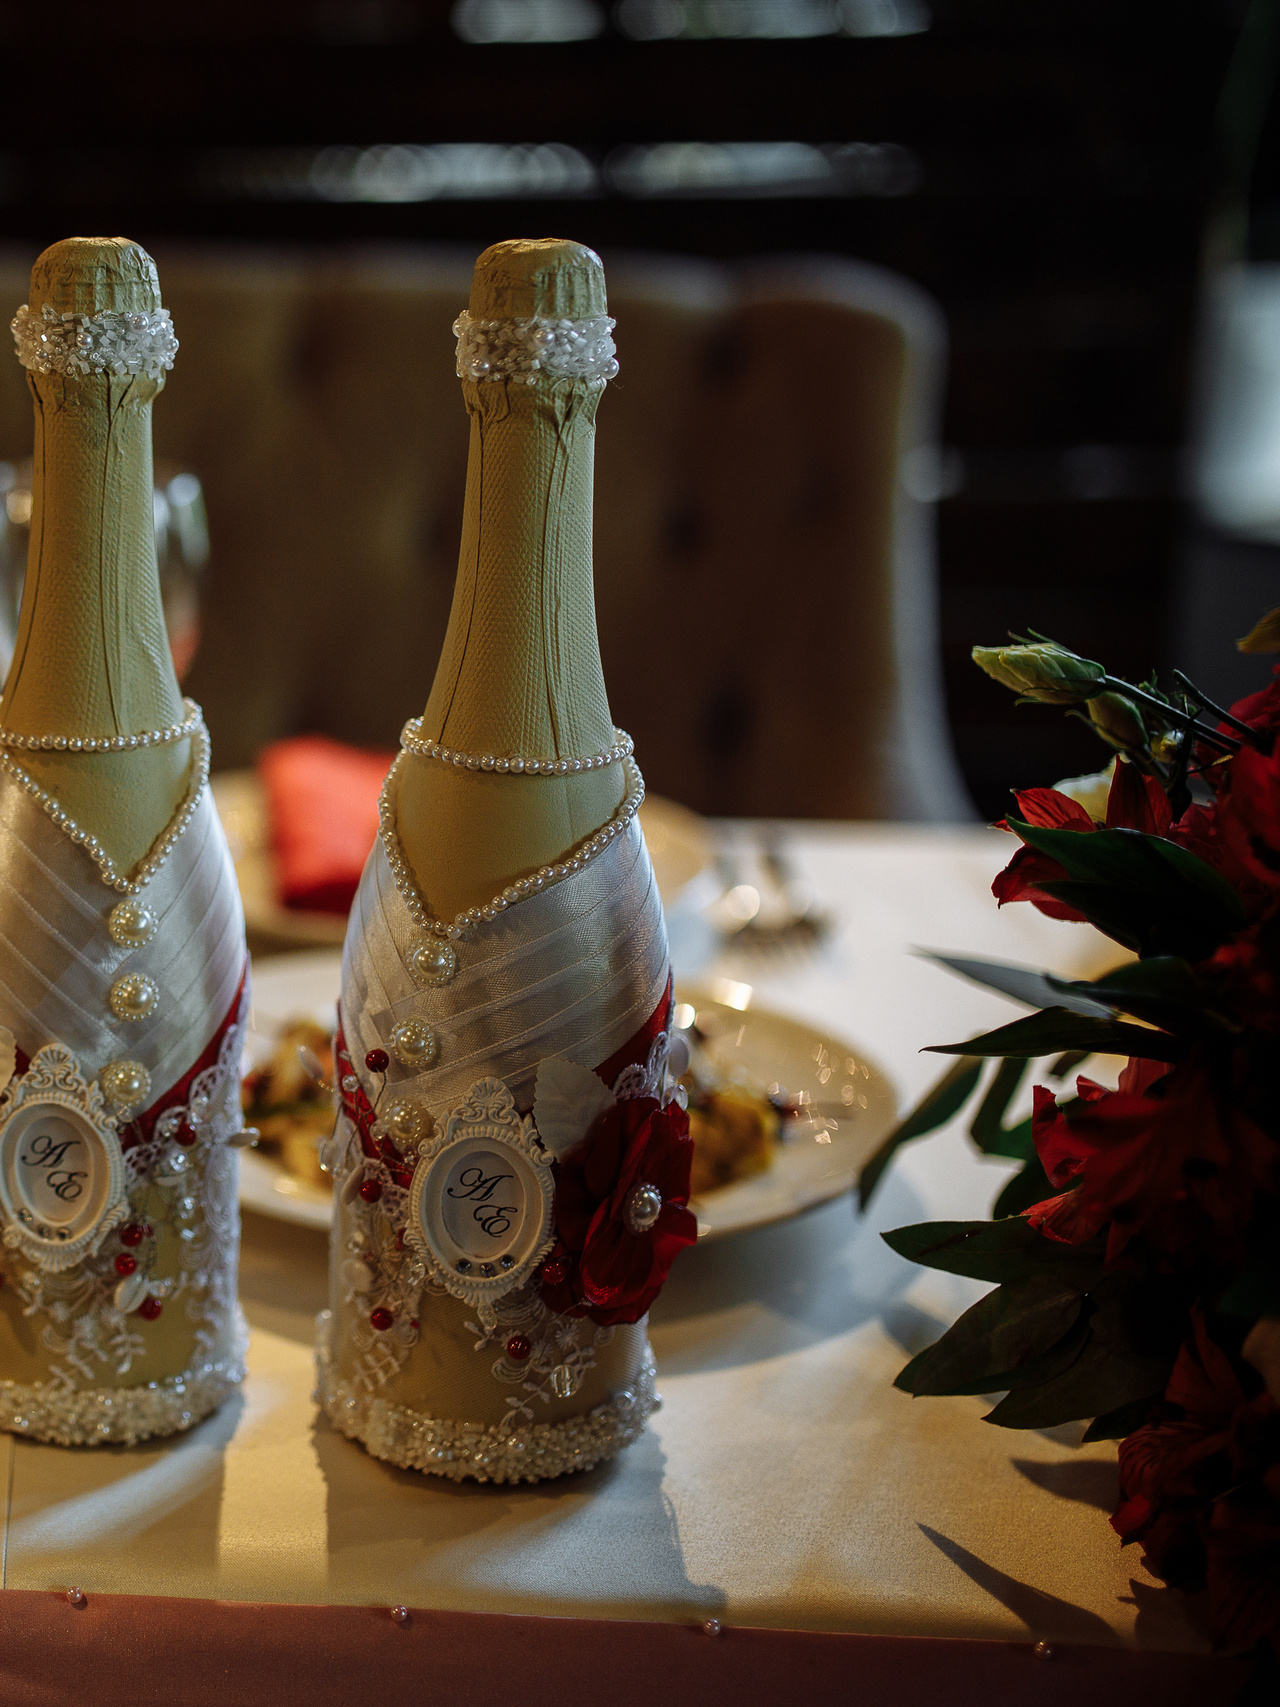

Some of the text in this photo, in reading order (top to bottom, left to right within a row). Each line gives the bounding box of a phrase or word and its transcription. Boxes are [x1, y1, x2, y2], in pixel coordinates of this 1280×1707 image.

[21, 1135, 81, 1168] A
[46, 1170, 88, 1203] E
[447, 1167, 514, 1201] A
[473, 1204, 518, 1238] E
